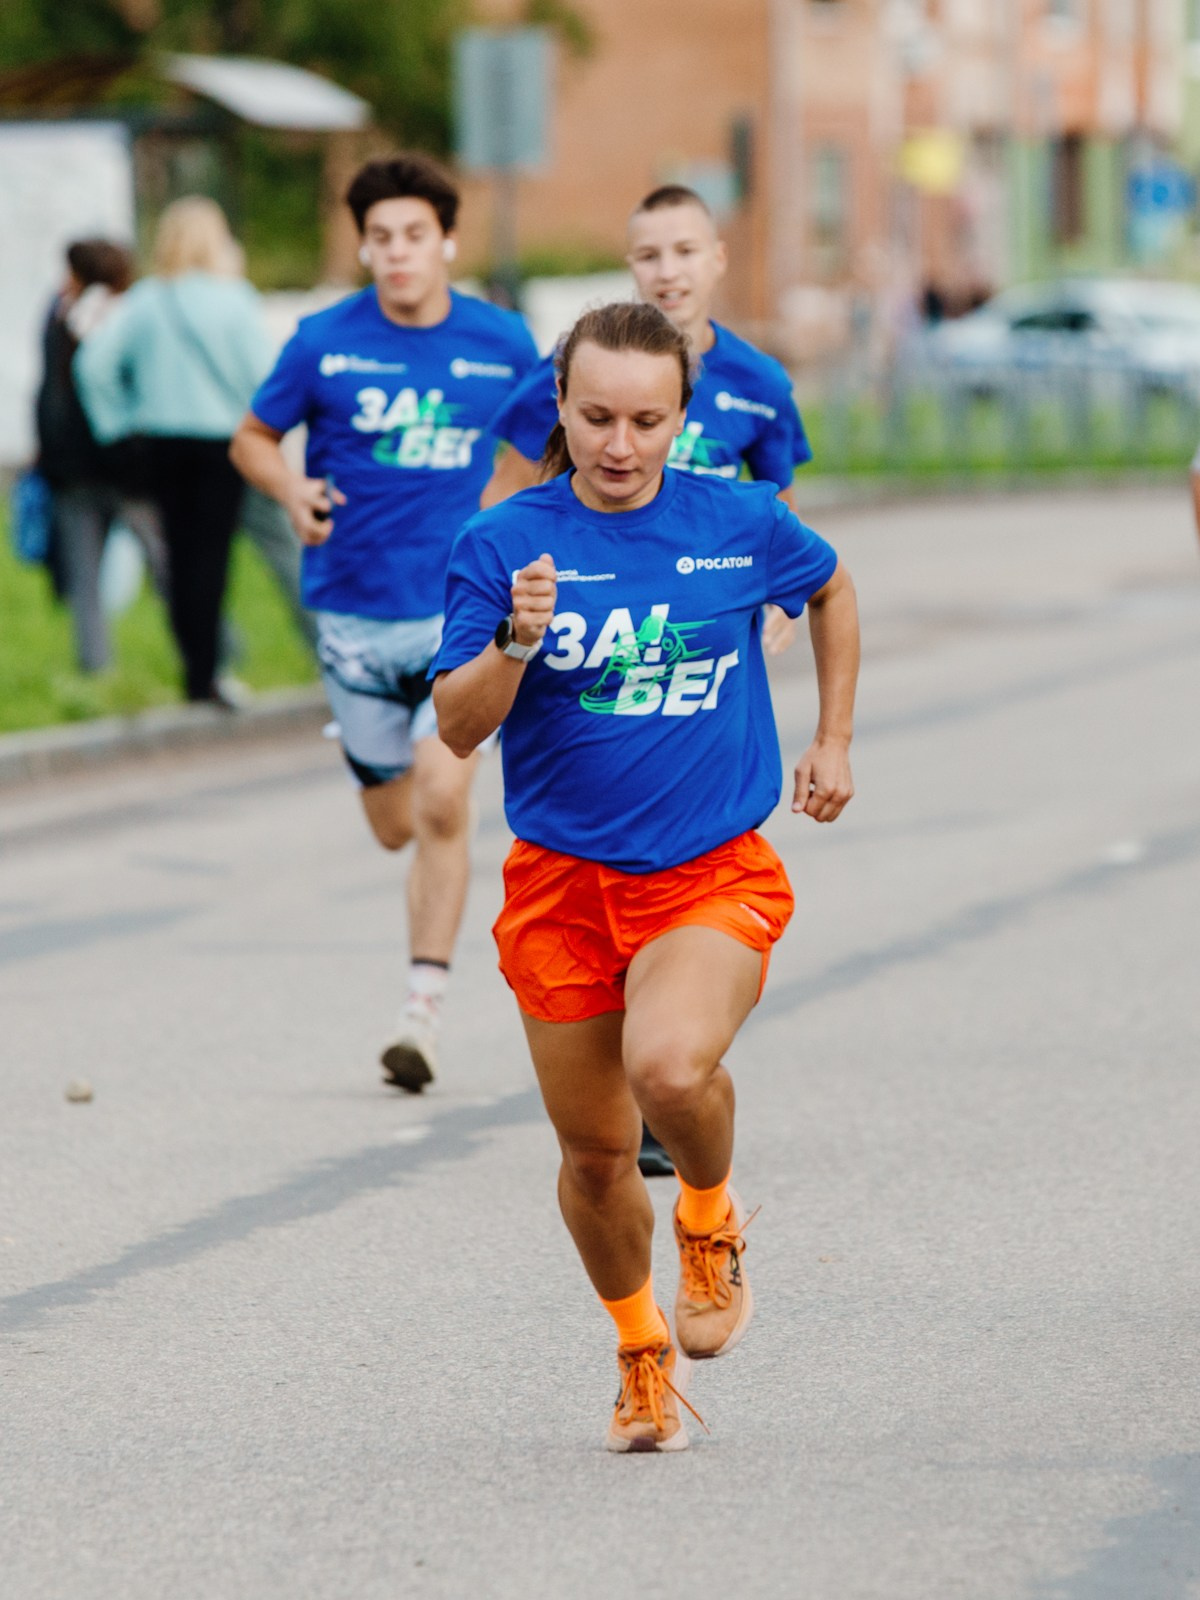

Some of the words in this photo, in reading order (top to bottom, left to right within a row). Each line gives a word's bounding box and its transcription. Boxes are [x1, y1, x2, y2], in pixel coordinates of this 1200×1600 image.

[696, 556, 753, 570] РОСАТОМ
[543, 603, 670, 671] ЗА!
[613, 648, 739, 716] БЕГ
